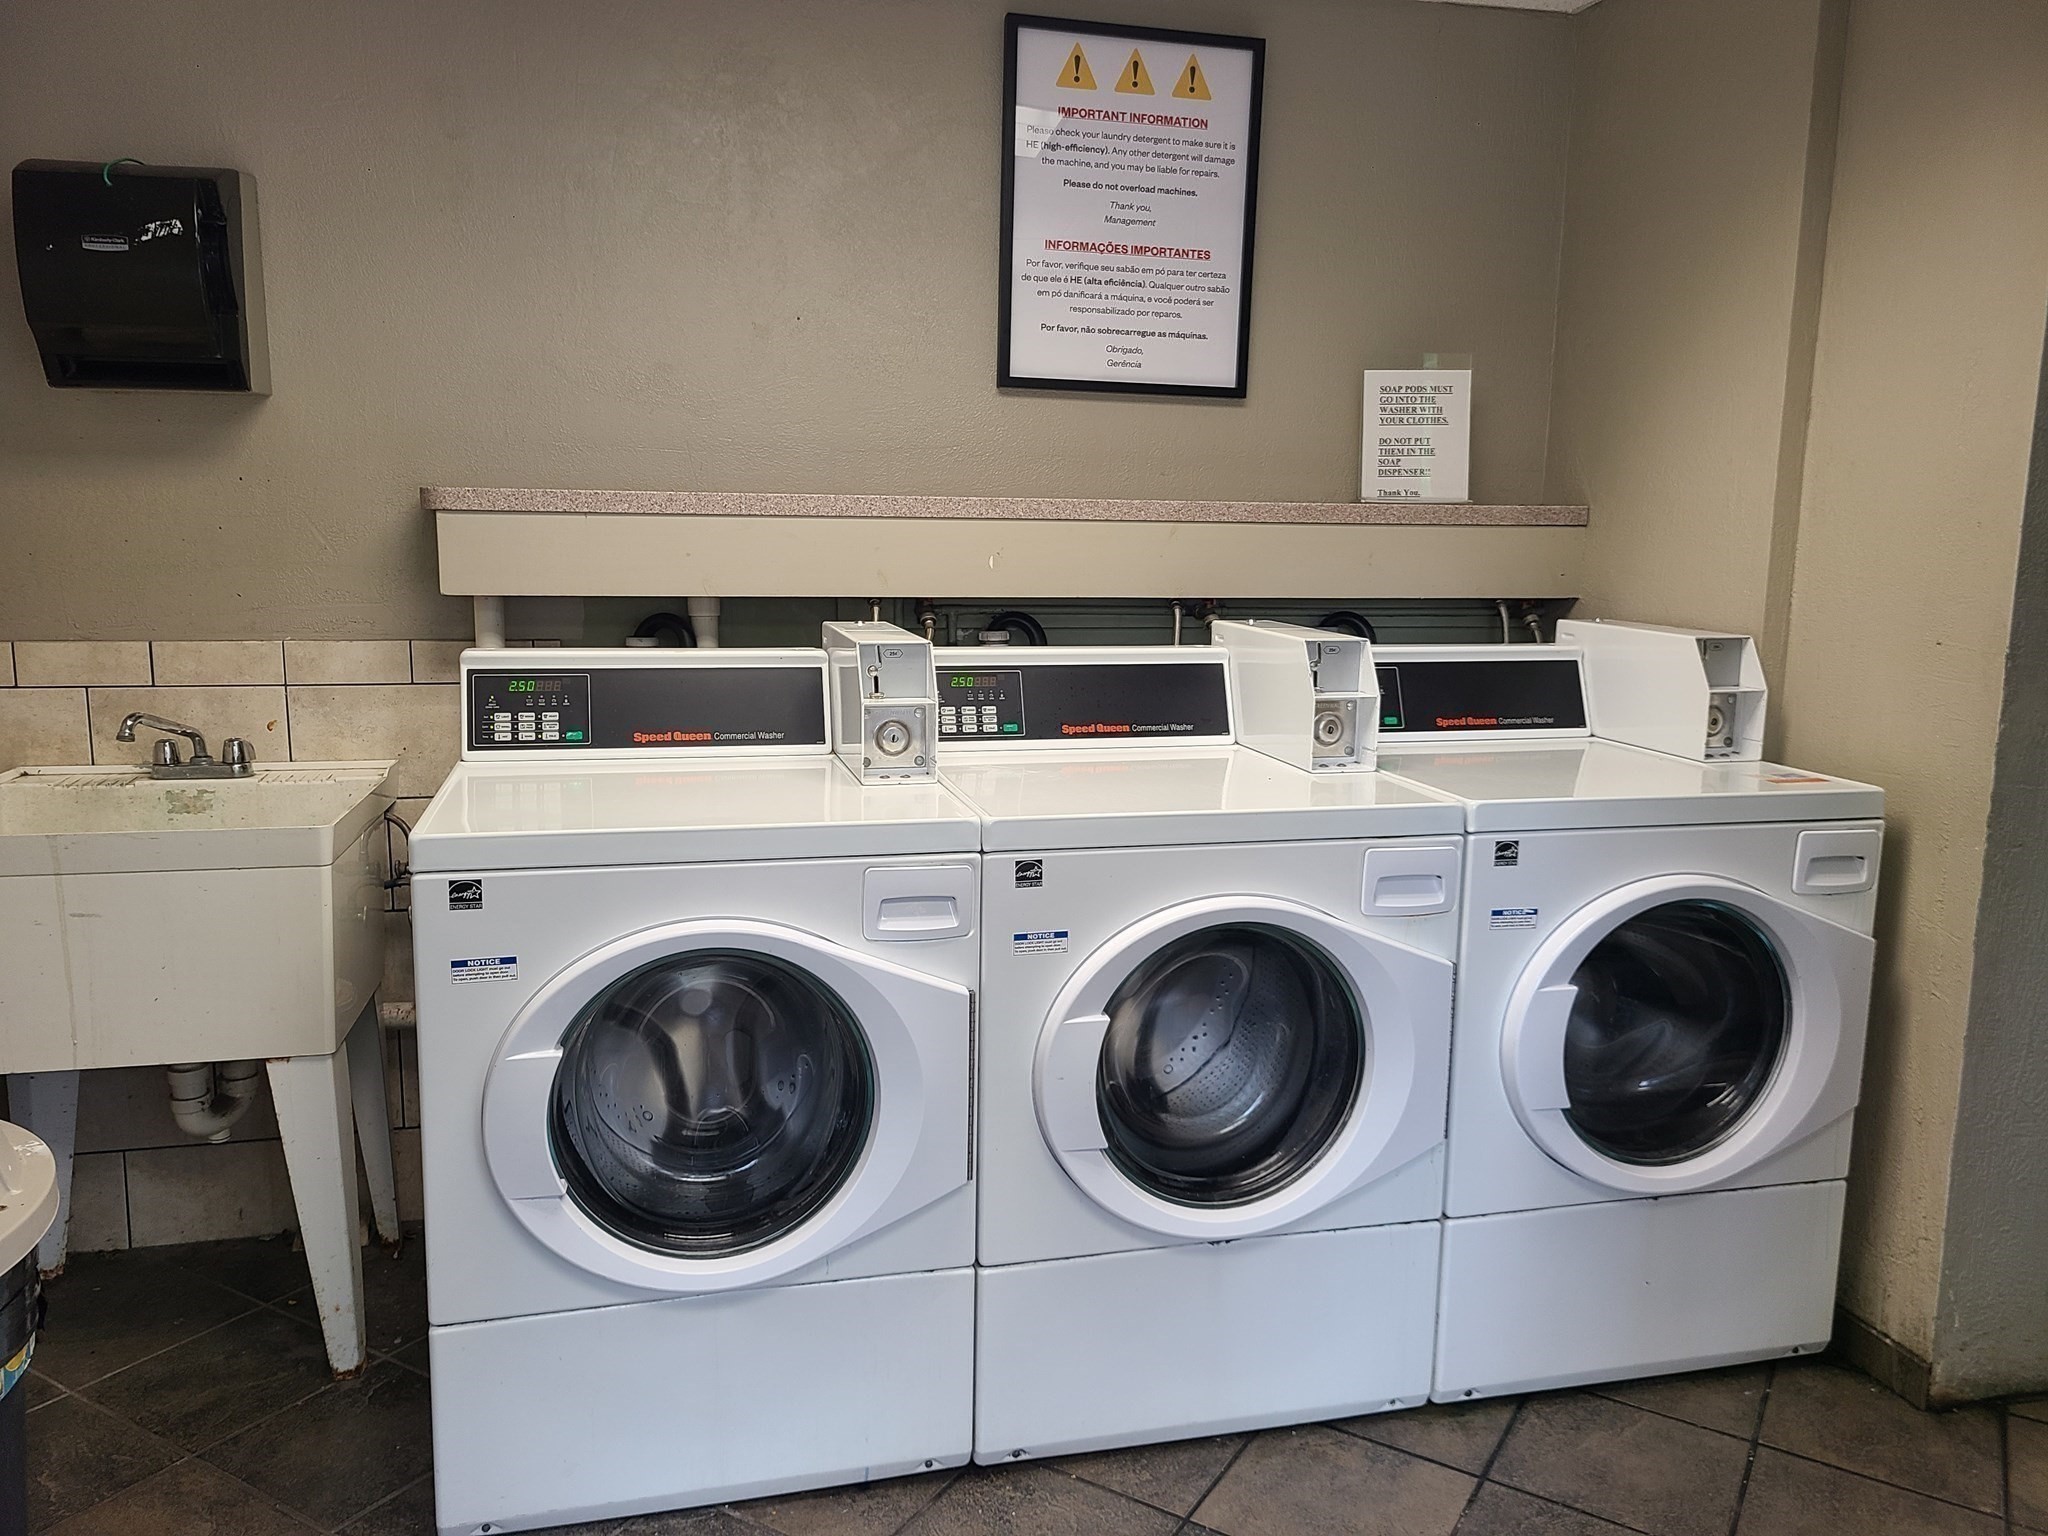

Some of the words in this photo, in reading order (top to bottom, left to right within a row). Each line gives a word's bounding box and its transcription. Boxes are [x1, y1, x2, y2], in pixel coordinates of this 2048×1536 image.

[1057, 106, 1127, 123] IMPORTANT
[1129, 112, 1208, 130] INFORMATION
[1026, 124, 1054, 136] Please
[1055, 128, 1081, 137] check
[1081, 131, 1100, 140] your
[1100, 130, 1131, 143] laundry
[1132, 133, 1171, 145] detergent
[1172, 137, 1180, 145] to
[1181, 138, 1203, 147] make
[1204, 141, 1222, 149] sure
[1222, 141, 1228, 150] it
[1229, 141, 1235, 150] is
[1026, 139, 1039, 148] HE
[1040, 140, 1110, 155] (high-efficiency).
[1110, 146, 1128, 157] Any
[1128, 148, 1150, 157] other
[1151, 149, 1189, 161] detergent
[1190, 153, 1203, 162] will
[1203, 154, 1235, 166] damage
[1041, 156, 1055, 165] the
[1056, 158, 1093, 169] machine,
[1093, 160, 1110, 169] and
[1110, 163, 1125, 171] you
[1126, 164, 1144, 173] may
[1145, 163, 1156, 172] be
[1156, 164, 1178, 174] liable
[1178, 166, 1190, 175] for
[1190, 168, 1220, 178] repairs.
[1062, 178, 1091, 188] Please
[1092, 180, 1103, 189] do
[1119, 184, 1156, 193] overload
[1156, 186, 1198, 196] machines.
[1109, 200, 1135, 210] Thank
[1103, 214, 1156, 226] Management
[1044, 239, 1129, 255] INFORMAÇÕES
[1130, 245, 1210, 261] IMPORTANTES
[1025, 258, 1040, 267] Por
[1041, 259, 1063, 269] favor,
[1064, 261, 1099, 272] verifique
[1100, 264, 1114, 272] seu
[1115, 264, 1140, 273] sabão
[1154, 266, 1165, 276] pó
[1166, 269, 1184, 277] para
[1197, 271, 1226, 279] certeza
[1020, 272, 1032, 281] de
[1032, 275, 1048, 283] que
[1049, 274, 1062, 283] ele
[1062, 275, 1068, 283] é
[1069, 275, 1082, 284] HE
[1083, 276, 1102, 285] (alta
[1103, 277, 1147, 289] eficiência).
[1148, 280, 1185, 291] Qualquer
[1184, 284, 1206, 292] outro
[1206, 284, 1230, 293] sabão
[1051, 289, 1062, 298] pó
[1062, 289, 1103, 300] danificará
[1110, 292, 1146, 303] máquina,
[1153, 295, 1172, 304] você
[1173, 296, 1201, 306] poderá
[1069, 306, 1135, 316] responsabilizado
[1150, 310, 1182, 319] reparos.
[1040, 322, 1055, 331] Por
[1056, 323, 1079, 334] favor,
[1080, 325, 1096, 334] não
[1096, 326, 1156, 338] sobrecarregue
[1167, 330, 1208, 340] máquinas.
[1106, 359, 1142, 368] Gerência
[1379, 385, 1403, 393] SOAP
[1404, 385, 1427, 393] PODS
[1429, 385, 1454, 393] MUST
[1379, 406, 1417, 414] WASHER
[1419, 406, 1442, 414] WITH
[1379, 416, 1405, 424] YOUR
[1406, 416, 1449, 424] CLOTHES.
[1378, 437, 1392, 445] DO
[1393, 437, 1412, 445] NOT
[1377, 458, 1401, 466] SOAP
[1436, 717, 1466, 727] Speed
[1467, 717, 1497, 725] Queen
[1498, 717, 1532, 725] Commercial
[1062, 724, 1095, 734] Speed
[1096, 724, 1130, 732] Queen
[1132, 724, 1169, 732] Commercial
[634, 732, 671, 743] Speed
[673, 732, 712, 741] Queen
[714, 732, 756, 740] Commercial
[758, 732, 784, 740] Washer
